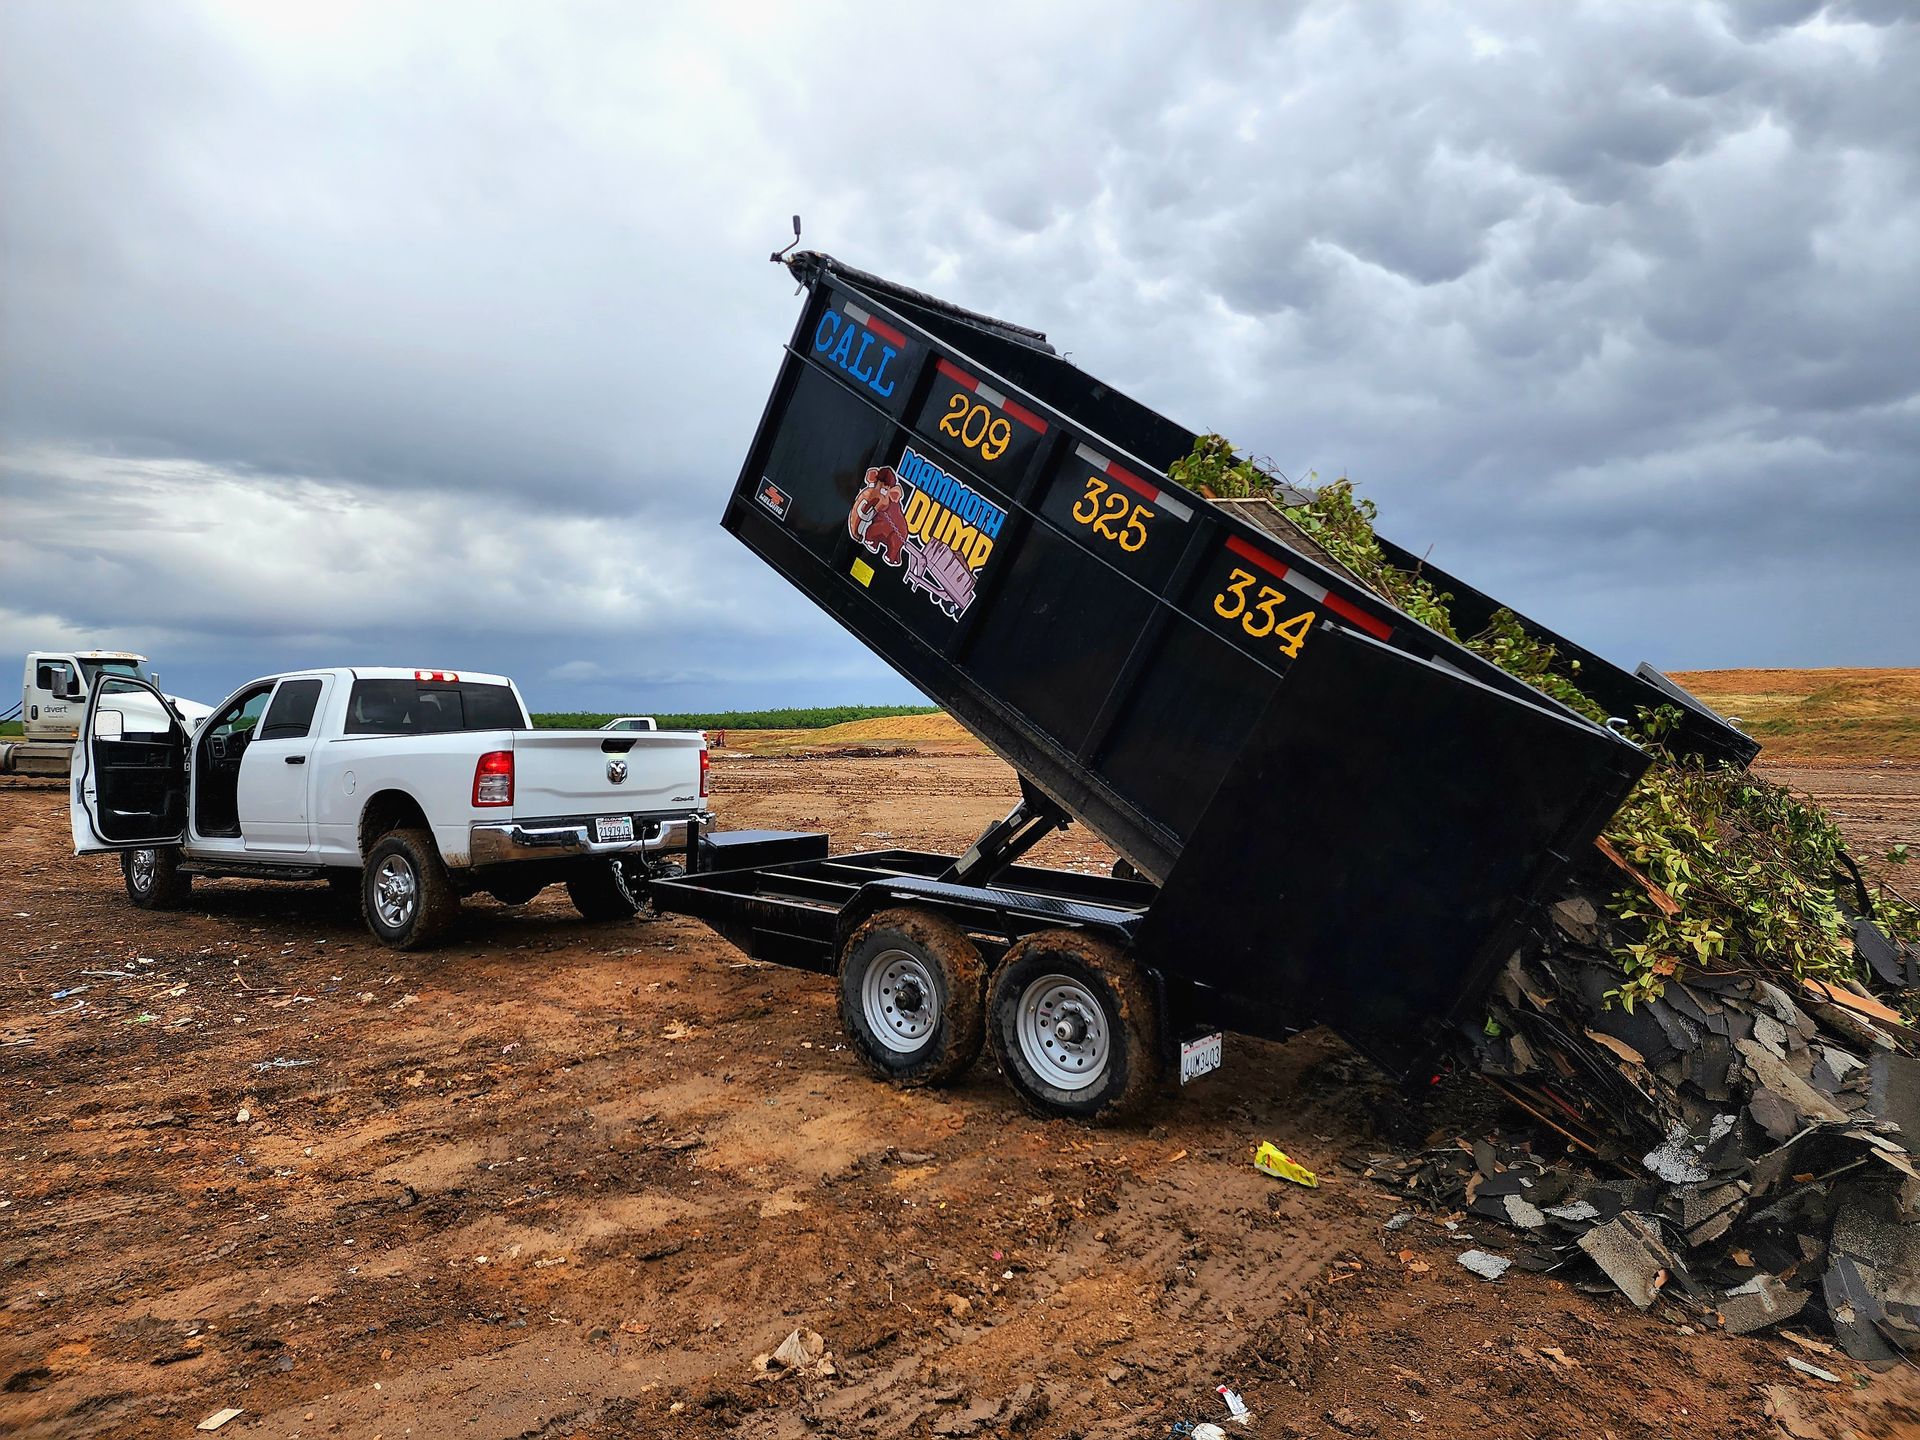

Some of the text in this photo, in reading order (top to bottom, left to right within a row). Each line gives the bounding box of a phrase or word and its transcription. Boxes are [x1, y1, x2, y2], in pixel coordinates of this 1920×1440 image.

[759, 493, 784, 515] WELDING
[815, 309, 1316, 659] CALL 209 325 334
[899, 449, 1006, 539] MAMMOTH
[904, 489, 995, 571] DUMP
[44, 704, 68, 713] divert
